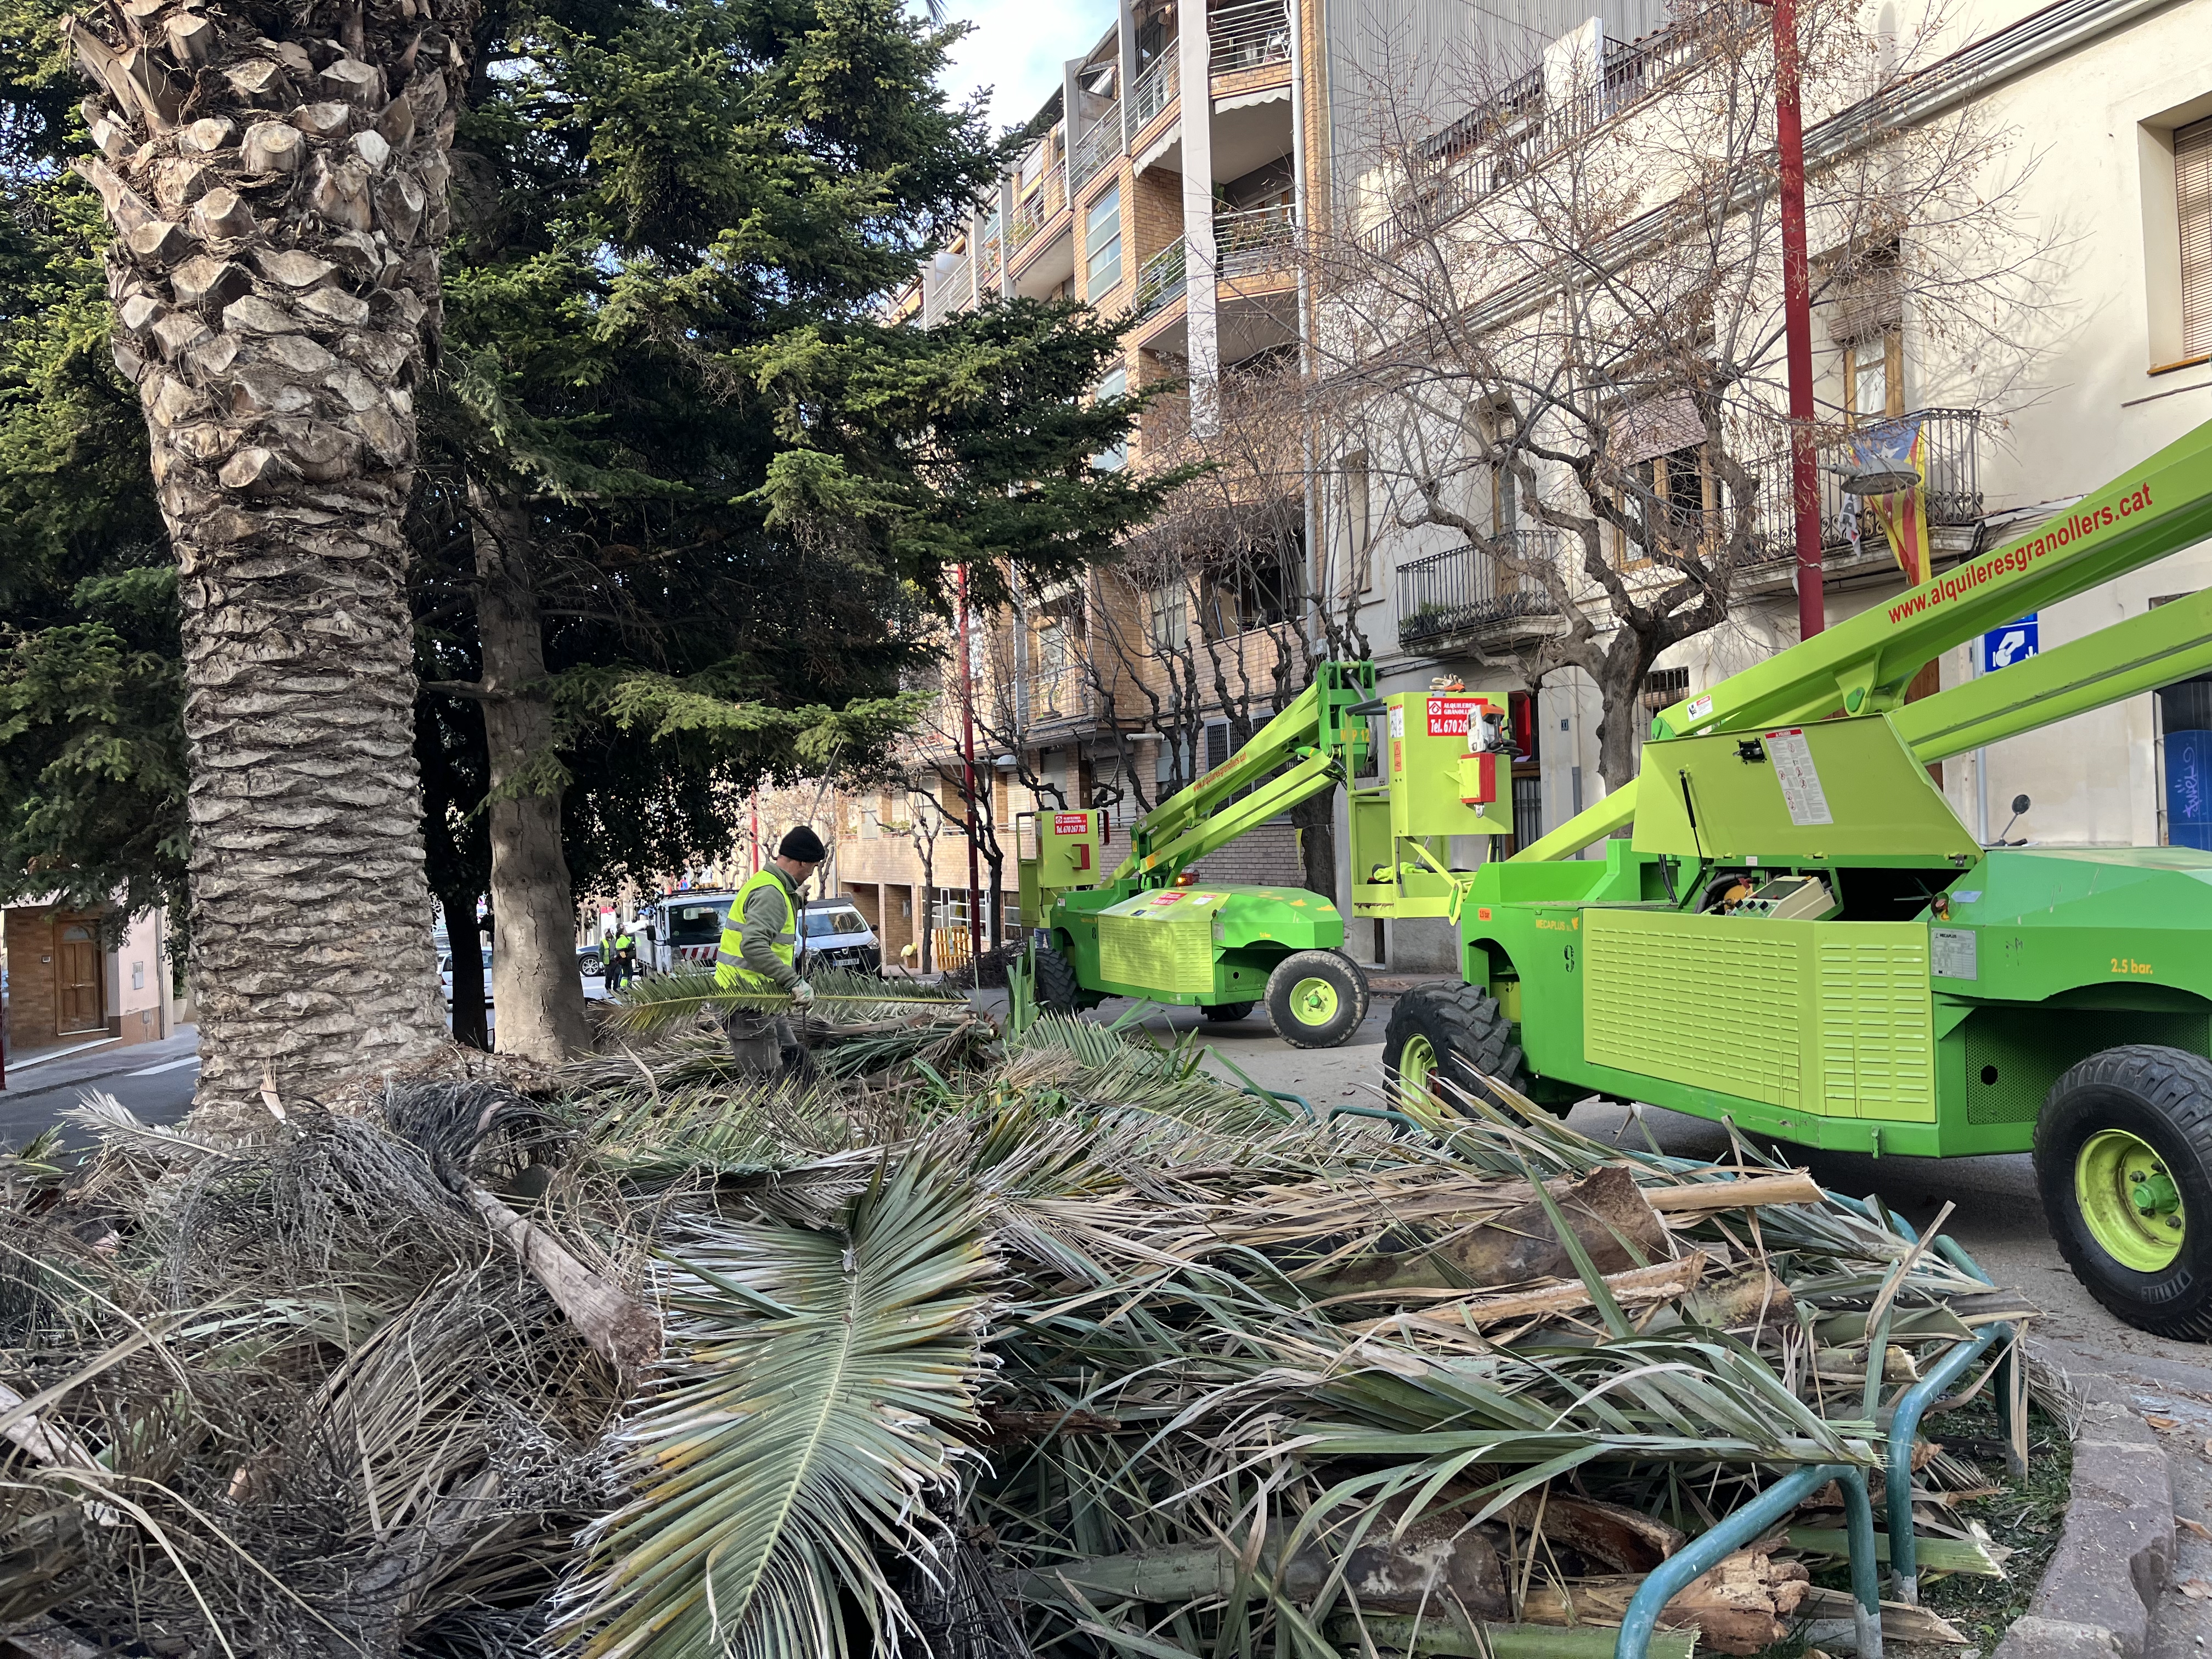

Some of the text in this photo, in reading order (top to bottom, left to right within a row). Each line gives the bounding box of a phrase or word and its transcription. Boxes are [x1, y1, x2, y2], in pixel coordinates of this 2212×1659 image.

[1431, 719, 1442, 733] Tel.
[1443, 719, 1457, 733] 670
[1458, 719, 1468, 733] 26
[1340, 729, 1357, 742] MP
[1564, 944, 1575, 973] 9
[2111, 958, 2153, 974] 2.5 bar.
